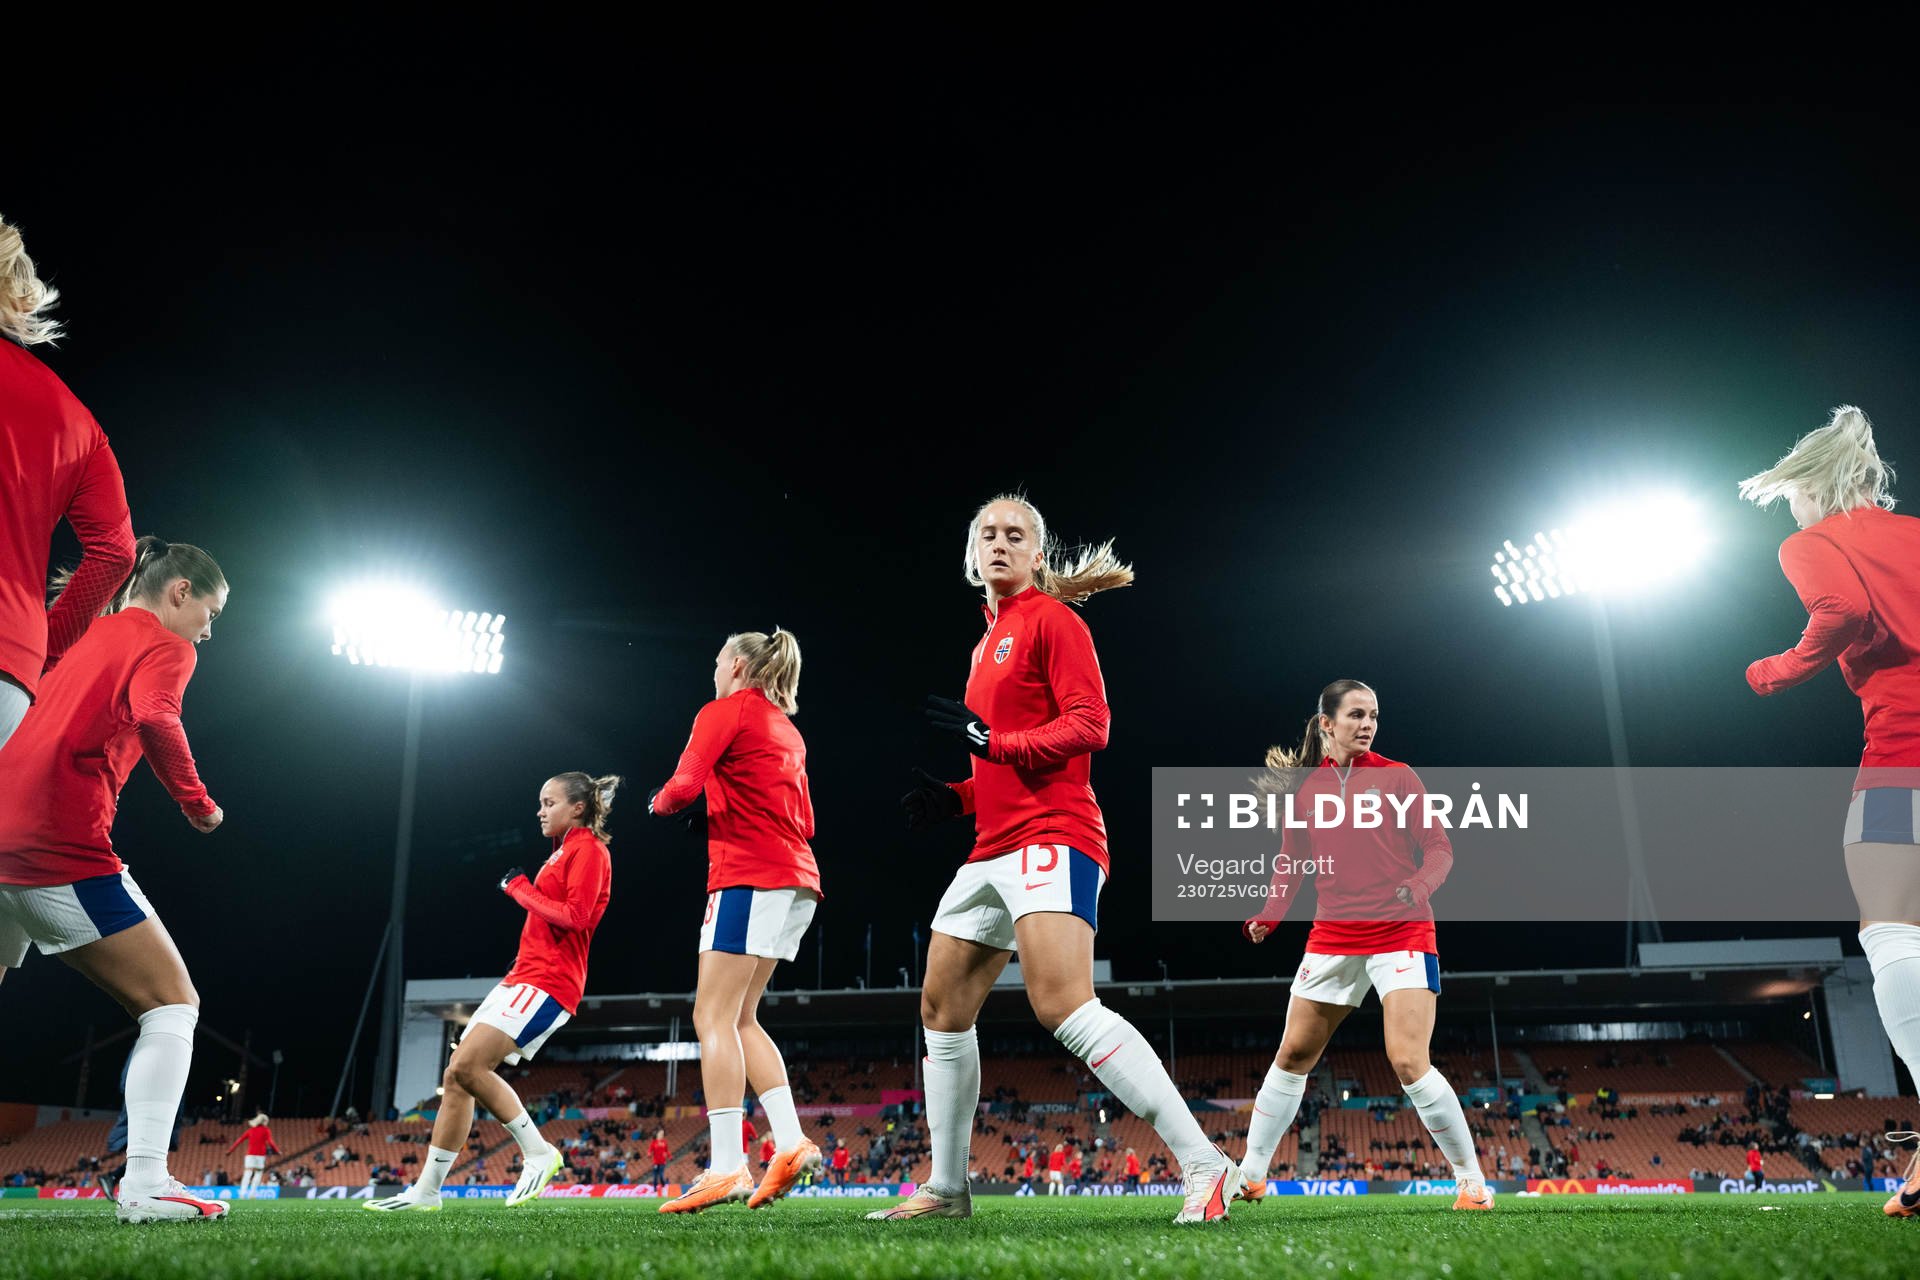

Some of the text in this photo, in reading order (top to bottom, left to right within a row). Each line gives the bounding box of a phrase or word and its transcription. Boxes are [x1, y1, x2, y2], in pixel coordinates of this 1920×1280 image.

[510, 984, 539, 1014] 11
[1298, 1181, 1358, 1195] VISA
[1596, 1183, 1686, 1195] McDonald's
